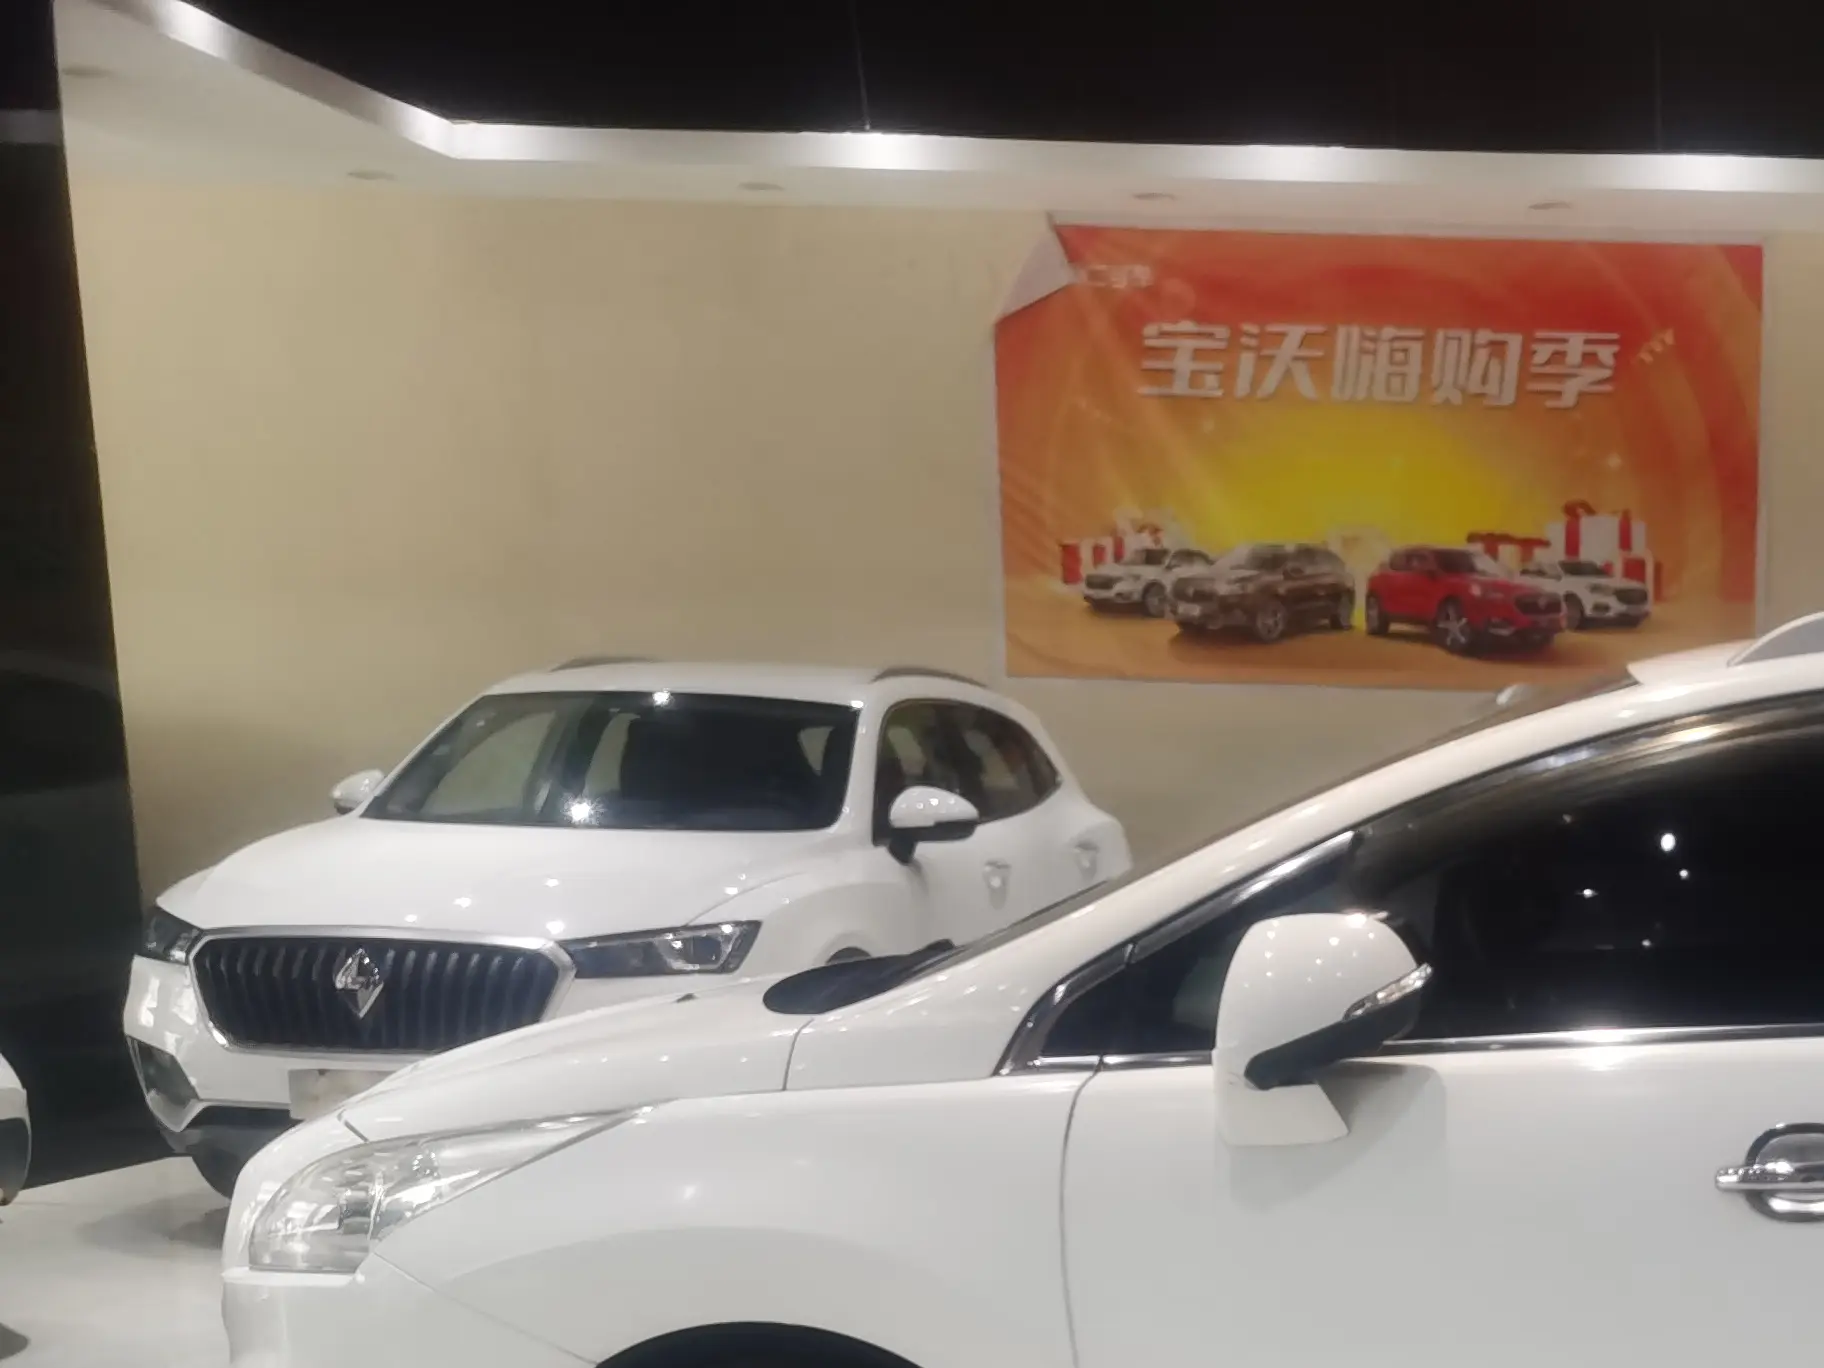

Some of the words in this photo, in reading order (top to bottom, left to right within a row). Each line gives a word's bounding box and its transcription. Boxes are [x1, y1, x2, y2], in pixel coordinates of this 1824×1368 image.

[1137, 319, 1621, 409] 宝沃嗨购季
